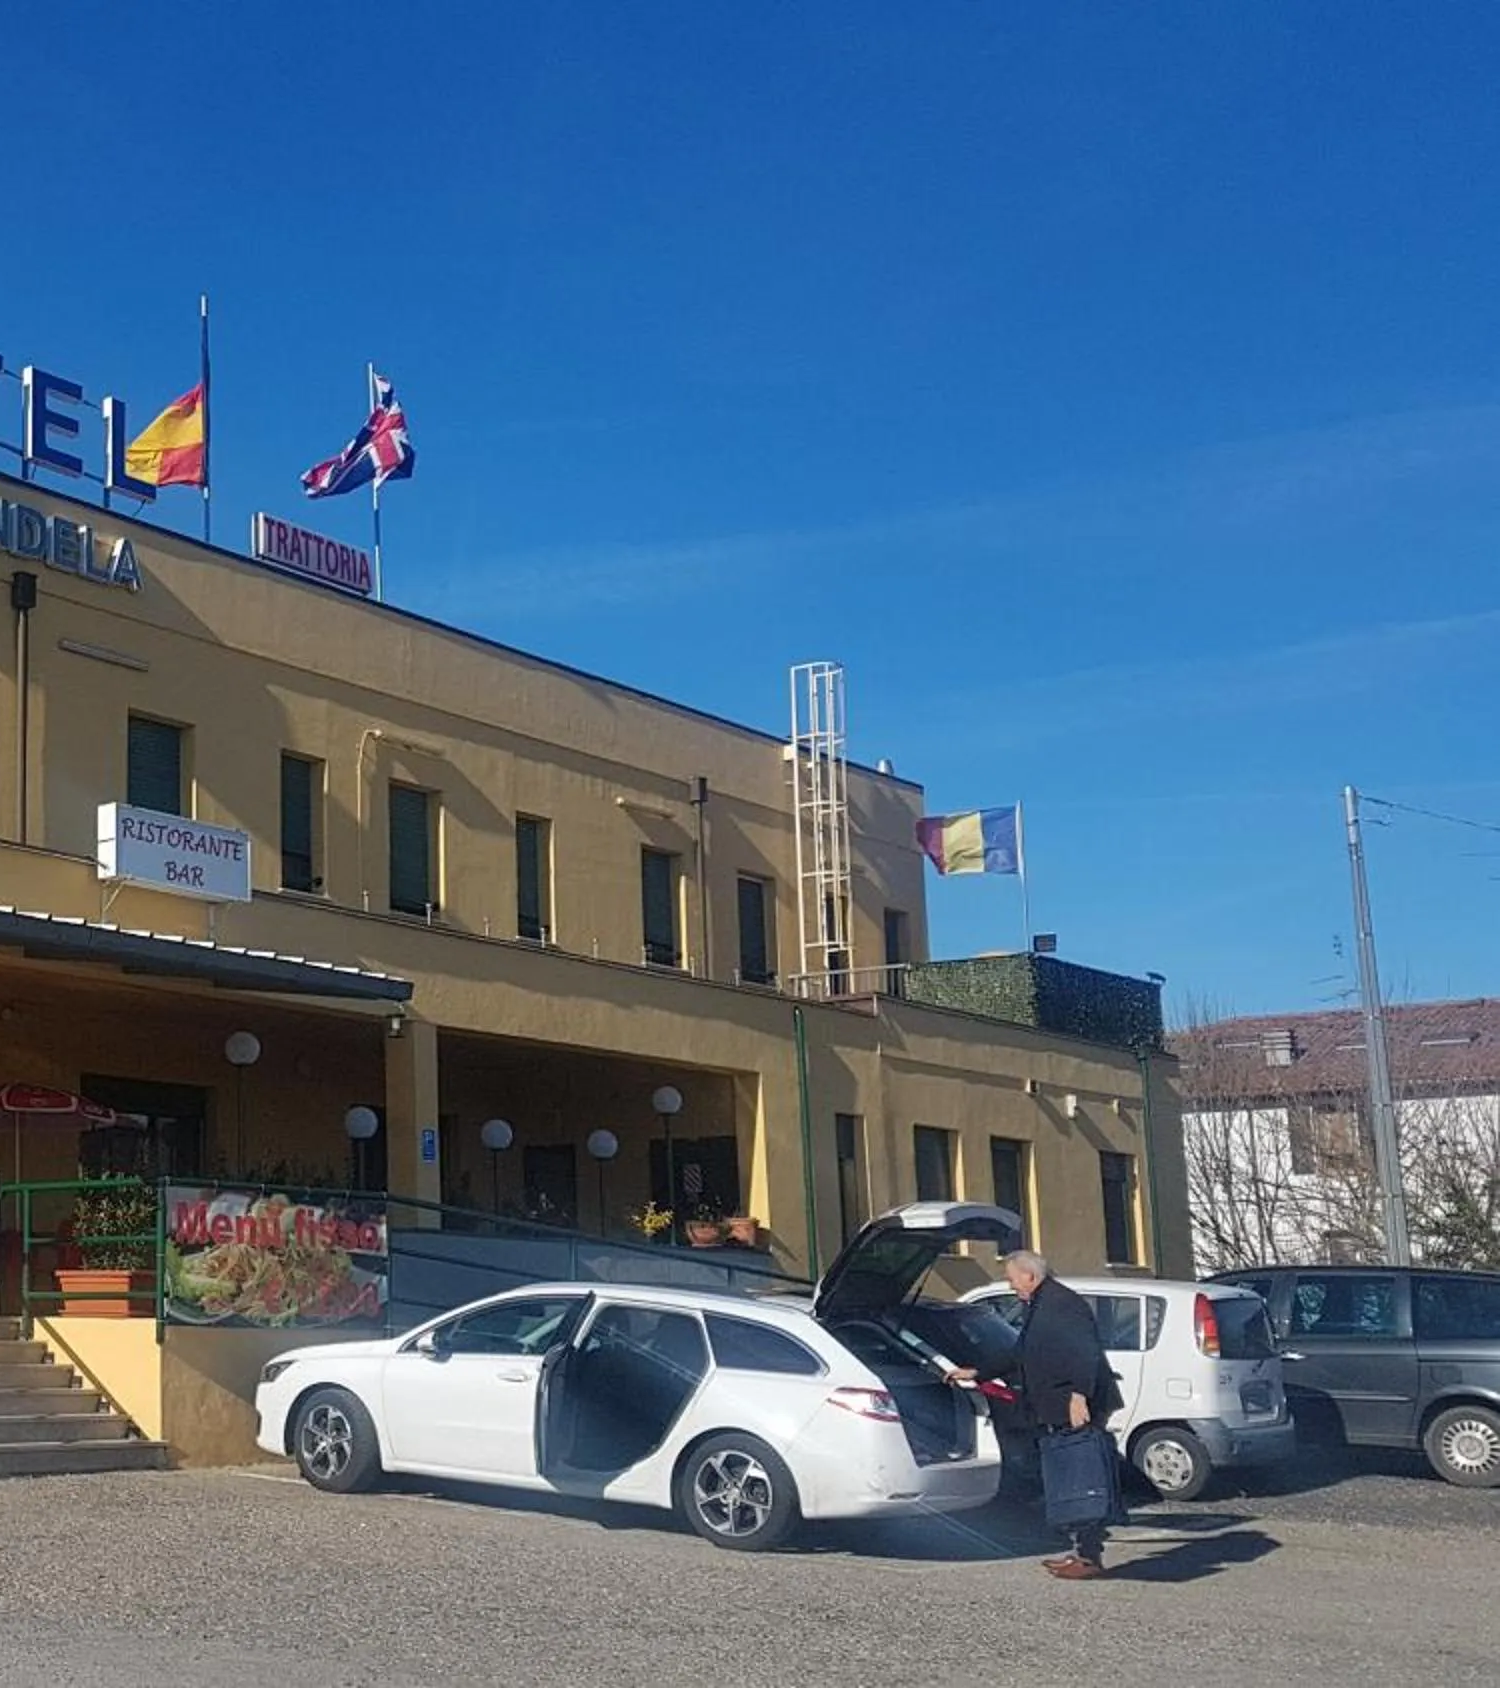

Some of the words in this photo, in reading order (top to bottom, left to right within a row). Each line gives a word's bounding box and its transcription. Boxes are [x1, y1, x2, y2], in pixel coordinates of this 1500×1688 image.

[264, 515, 372, 590] TRATTORIA
[121, 817, 244, 861] RISTORANTE
[164, 861, 205, 887] BAR
